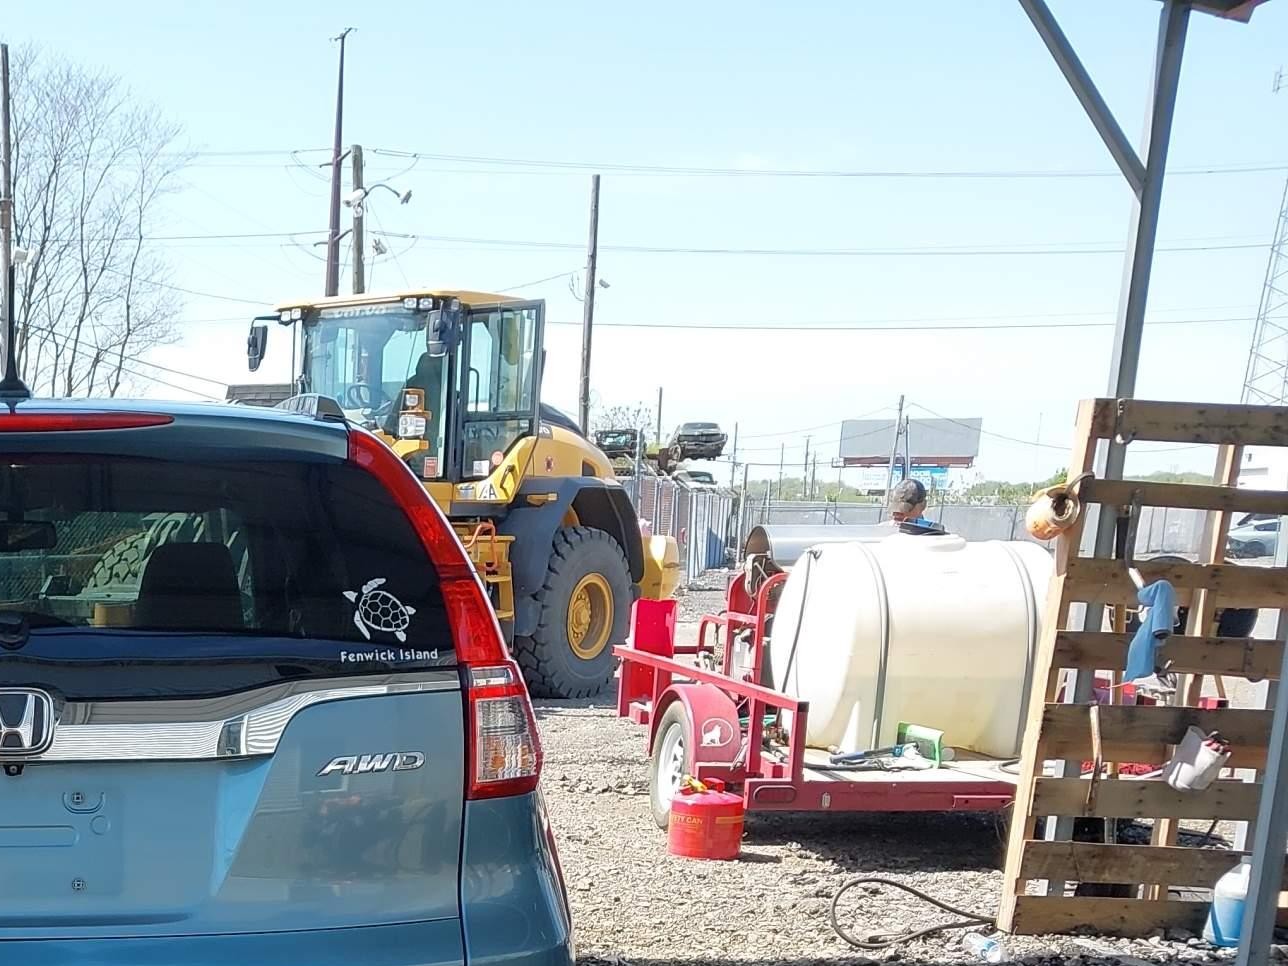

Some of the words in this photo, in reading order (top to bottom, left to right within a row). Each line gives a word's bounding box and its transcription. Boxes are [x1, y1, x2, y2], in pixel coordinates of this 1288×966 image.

[340, 649, 395, 663] Fenwick
[399, 648, 438, 660] Island
[315, 751, 426, 777] AWD
